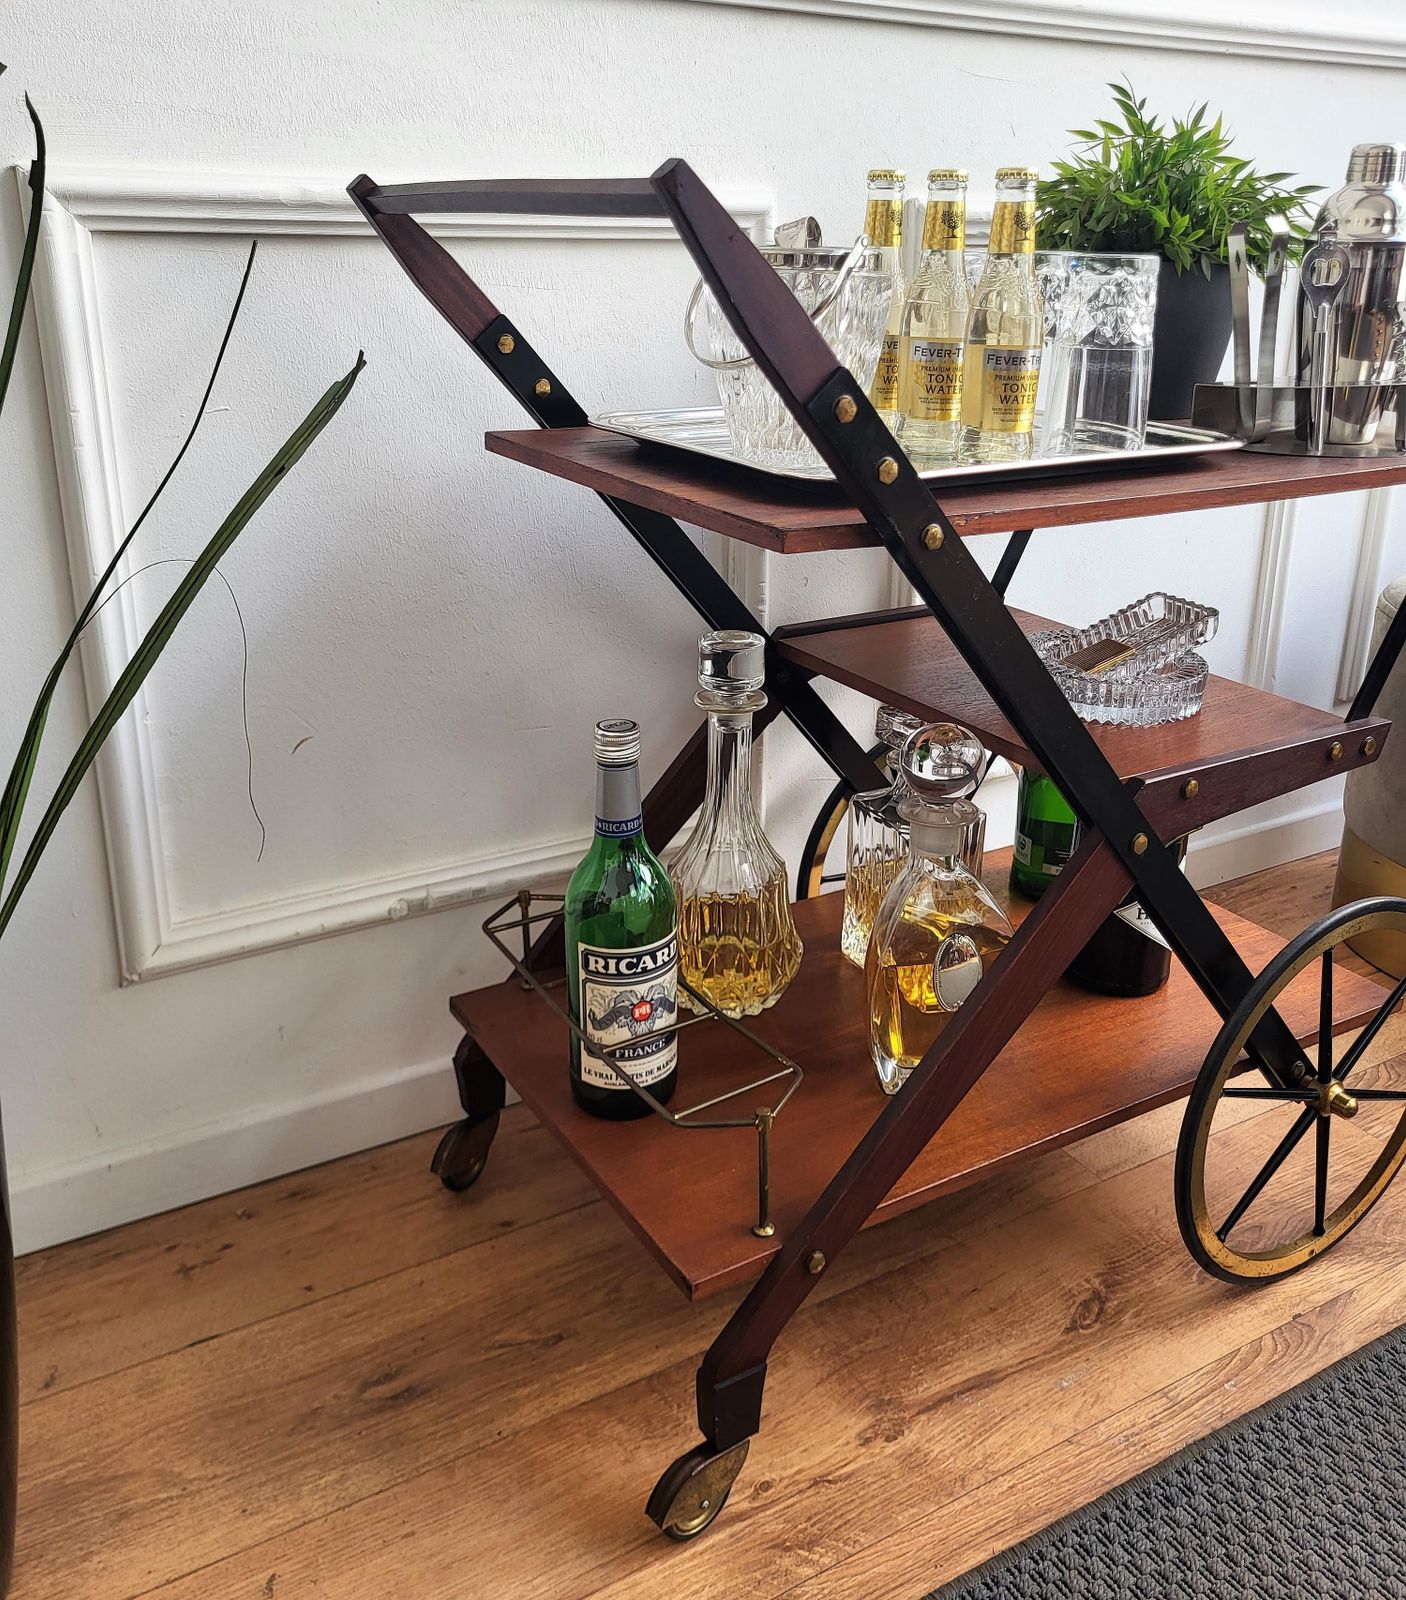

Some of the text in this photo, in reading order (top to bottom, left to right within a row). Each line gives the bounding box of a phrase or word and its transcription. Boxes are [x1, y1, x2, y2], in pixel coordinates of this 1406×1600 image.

[920, 365, 951, 373] PREMIUM
[1001, 383, 1036, 394] TONIC
[603, 819, 640, 832] RICARD
[587, 939, 677, 975] RICARD
[634, 1003, 651, 1018] PR
[615, 1038, 666, 1058] FRANCE
[584, 1066, 593, 1076] LE
[594, 1070, 613, 1081] VRAI
[645, 1066, 656, 1076] DE
